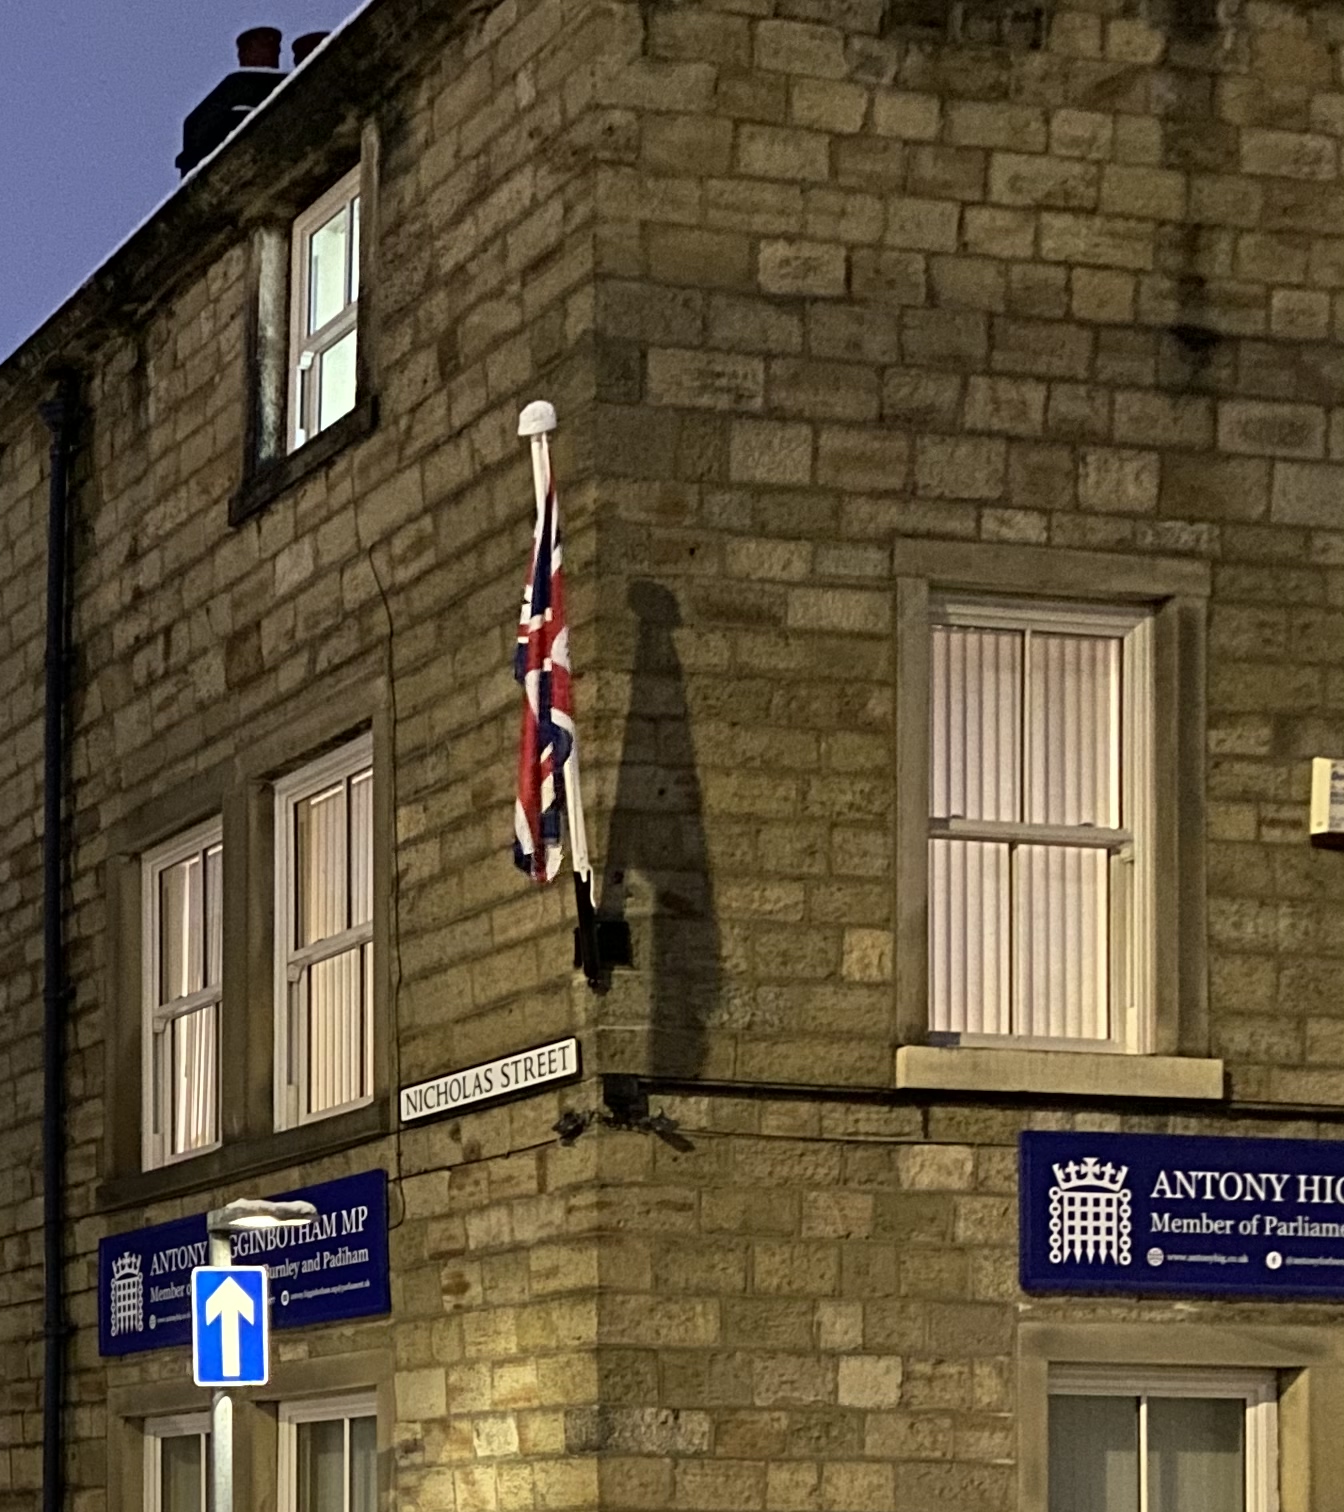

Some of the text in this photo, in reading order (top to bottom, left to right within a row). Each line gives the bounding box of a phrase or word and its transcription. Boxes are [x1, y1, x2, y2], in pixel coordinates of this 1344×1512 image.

[405, 1044, 571, 1116] NICHOLAS STREET
[1149, 1169, 1291, 1202] ANTONY
[1149, 1211, 1235, 1235] Member
[1238, 1213, 1262, 1236] of
[149, 1240, 209, 1277] ANTONY
[340, 1205, 369, 1236] MP
[301, 1251, 321, 1274] and
[322, 1245, 370, 1270] Padiham
[149, 1281, 186, 1303] Member
